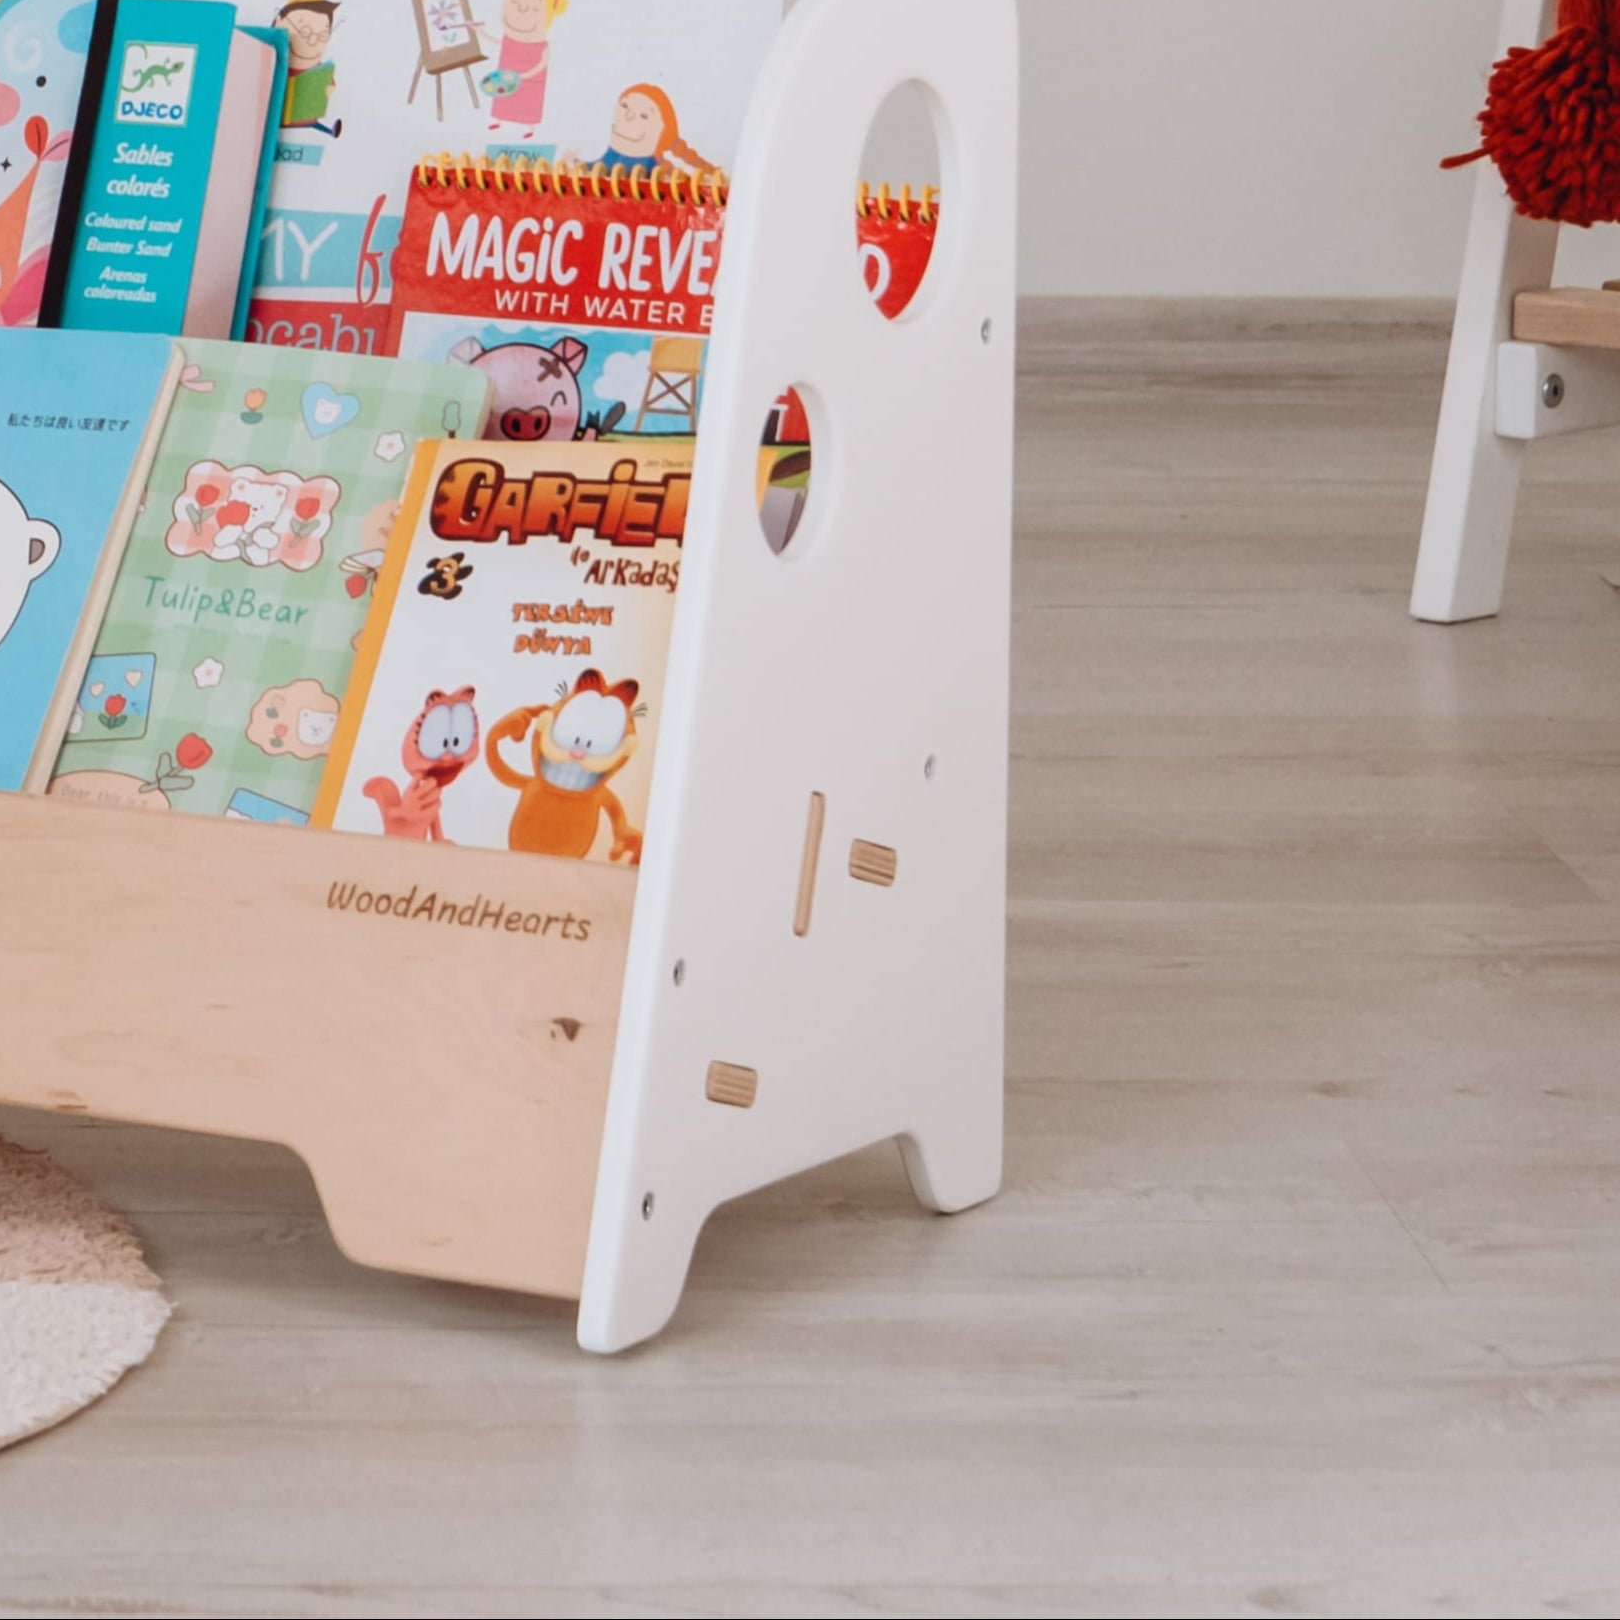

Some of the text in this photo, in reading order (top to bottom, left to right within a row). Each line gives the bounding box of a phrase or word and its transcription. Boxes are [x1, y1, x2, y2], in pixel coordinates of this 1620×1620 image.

[121, 101, 184, 120] DJECO
[113, 142, 174, 167] Sables
[106, 174, 170, 198] colorés
[84, 212, 182, 233] Coloured sand
[86, 237, 173, 257] Bunter Sand
[598, 222, 722, 297] REVE
[99, 265, 148, 284] Arenas
[83, 284, 158, 302] coloreadas
[494, 288, 569, 316] WITH
[584, 295, 685, 326] WATER
[430, 557, 460, 596] 3
[144, 575, 310, 624] Tulip&Bear
[326, 881, 593, 942] WoodAndHearts
